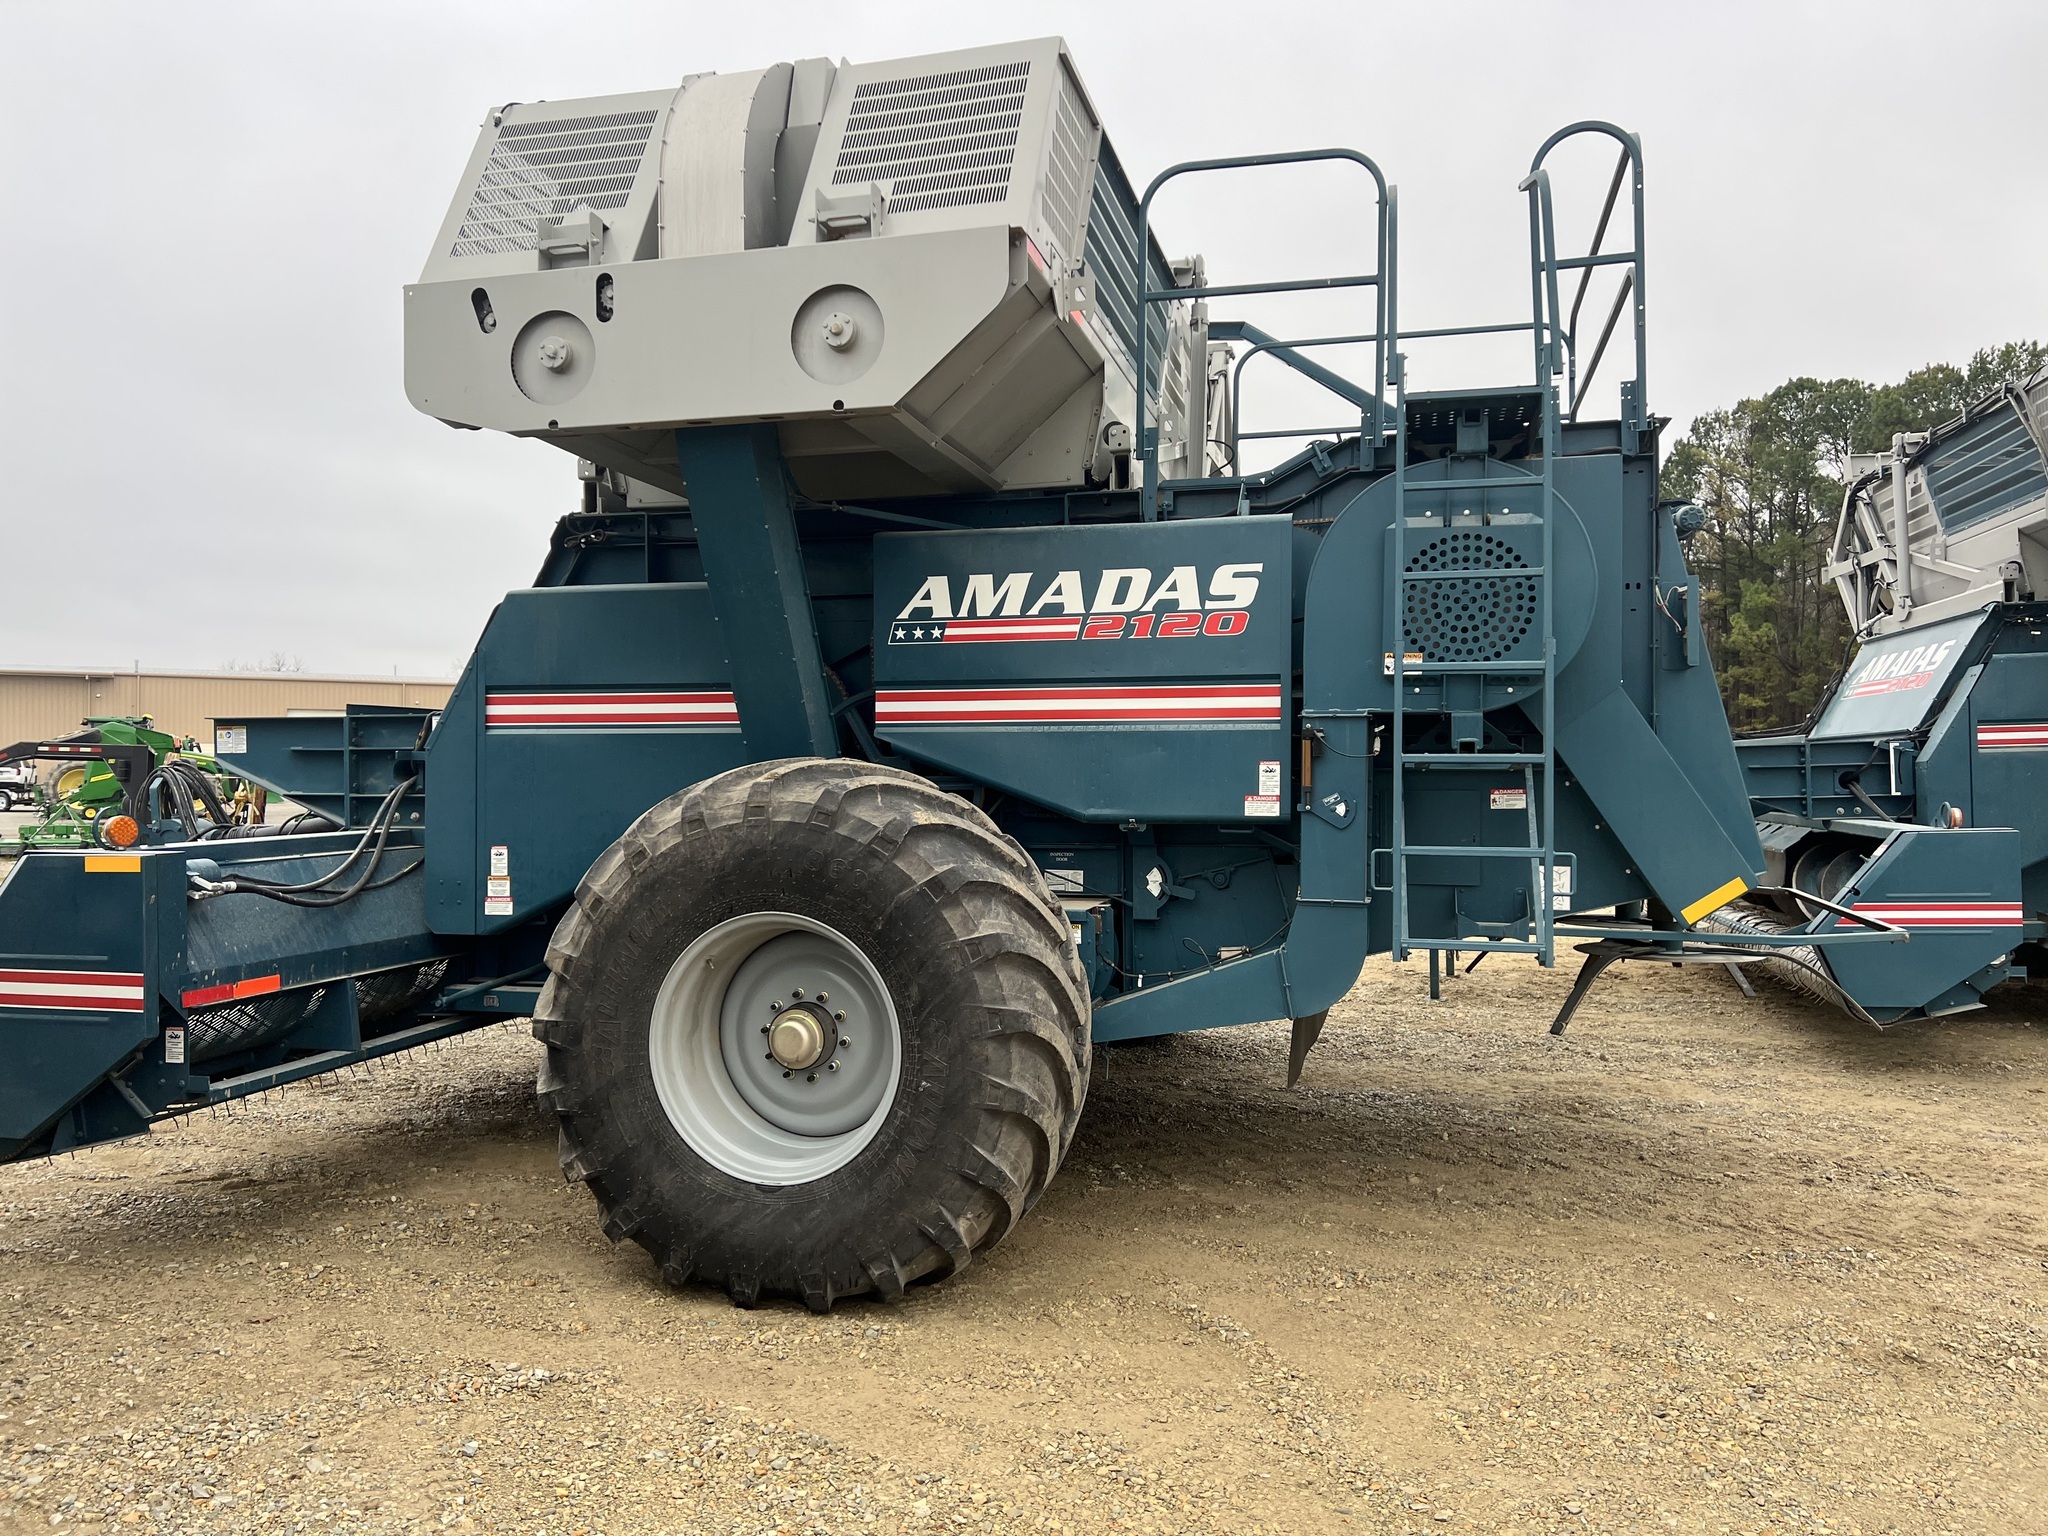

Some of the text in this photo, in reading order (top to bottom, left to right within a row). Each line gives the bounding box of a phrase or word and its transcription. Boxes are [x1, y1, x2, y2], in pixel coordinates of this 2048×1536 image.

[896, 563, 1264, 619] AMADAS
[1082, 611, 1250, 641] 2120
[1852, 640, 1957, 684] AMADAS
[803, 849, 869, 892] 360
